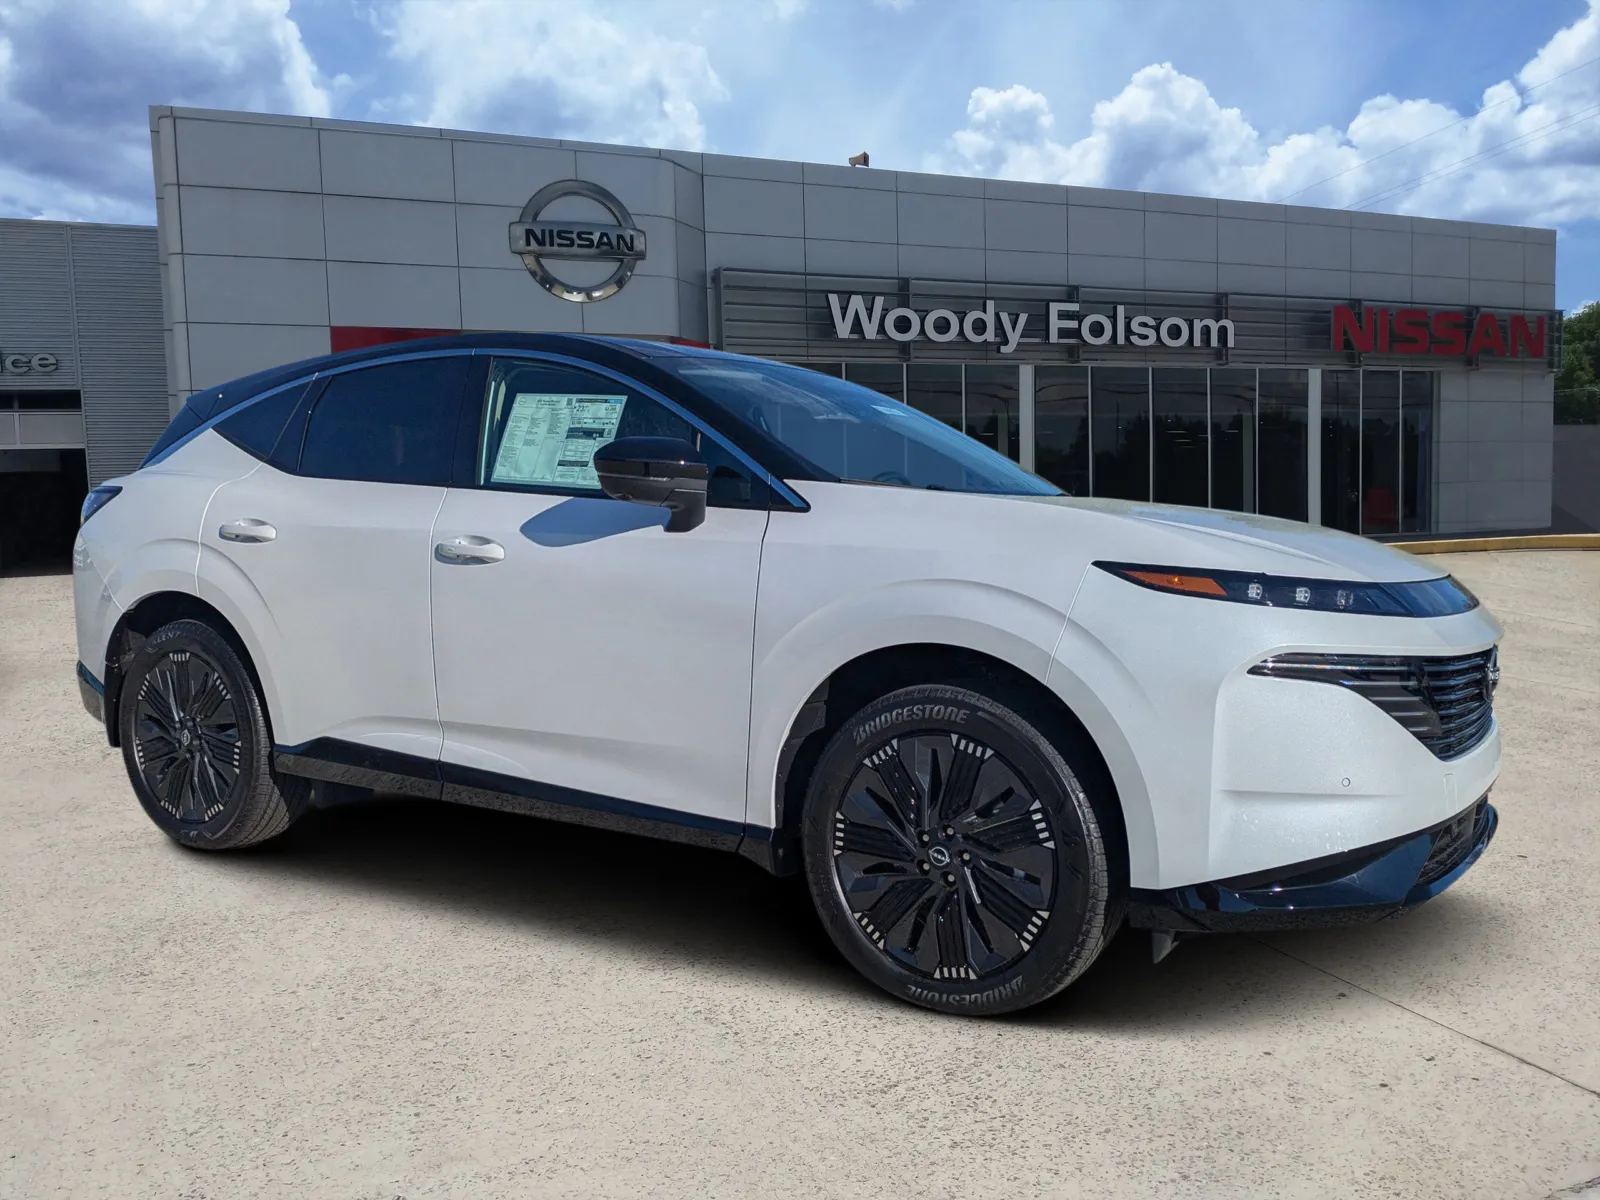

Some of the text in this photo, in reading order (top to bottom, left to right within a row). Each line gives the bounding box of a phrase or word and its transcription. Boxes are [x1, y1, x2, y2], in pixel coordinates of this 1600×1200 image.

[525, 228, 635, 252] NISSAN
[828, 293, 1235, 353] Woody Folsom
[1333, 305, 1545, 358] NISSAN
[0, 353, 58, 373] ce
[853, 705, 970, 745] BRIDGESTONE
